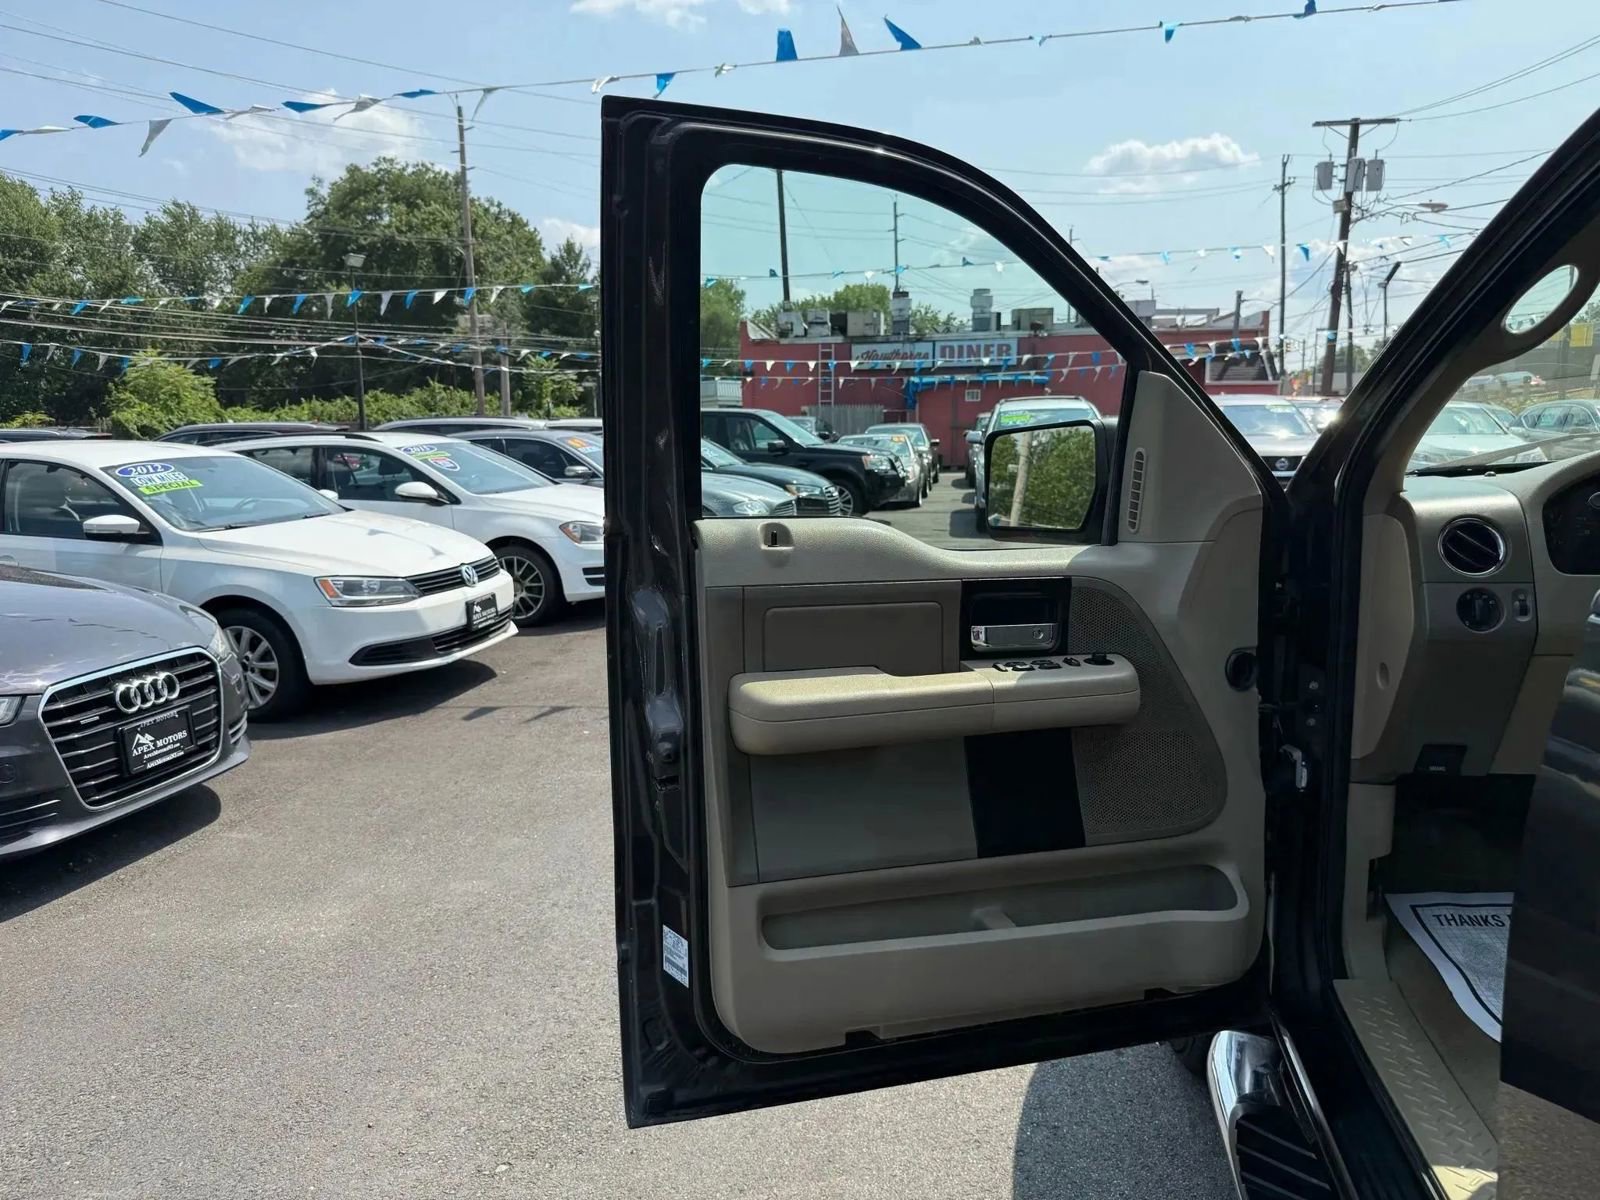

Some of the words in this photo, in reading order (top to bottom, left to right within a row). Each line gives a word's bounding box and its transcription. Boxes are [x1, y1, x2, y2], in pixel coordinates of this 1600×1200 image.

[939, 343, 1013, 363] DINER
[127, 463, 164, 476] 2012
[144, 480, 195, 492] SPECIAL
[132, 742, 155, 757] APEX
[156, 730, 188, 747] MOTORS
[1432, 914, 1505, 928] THANKS
